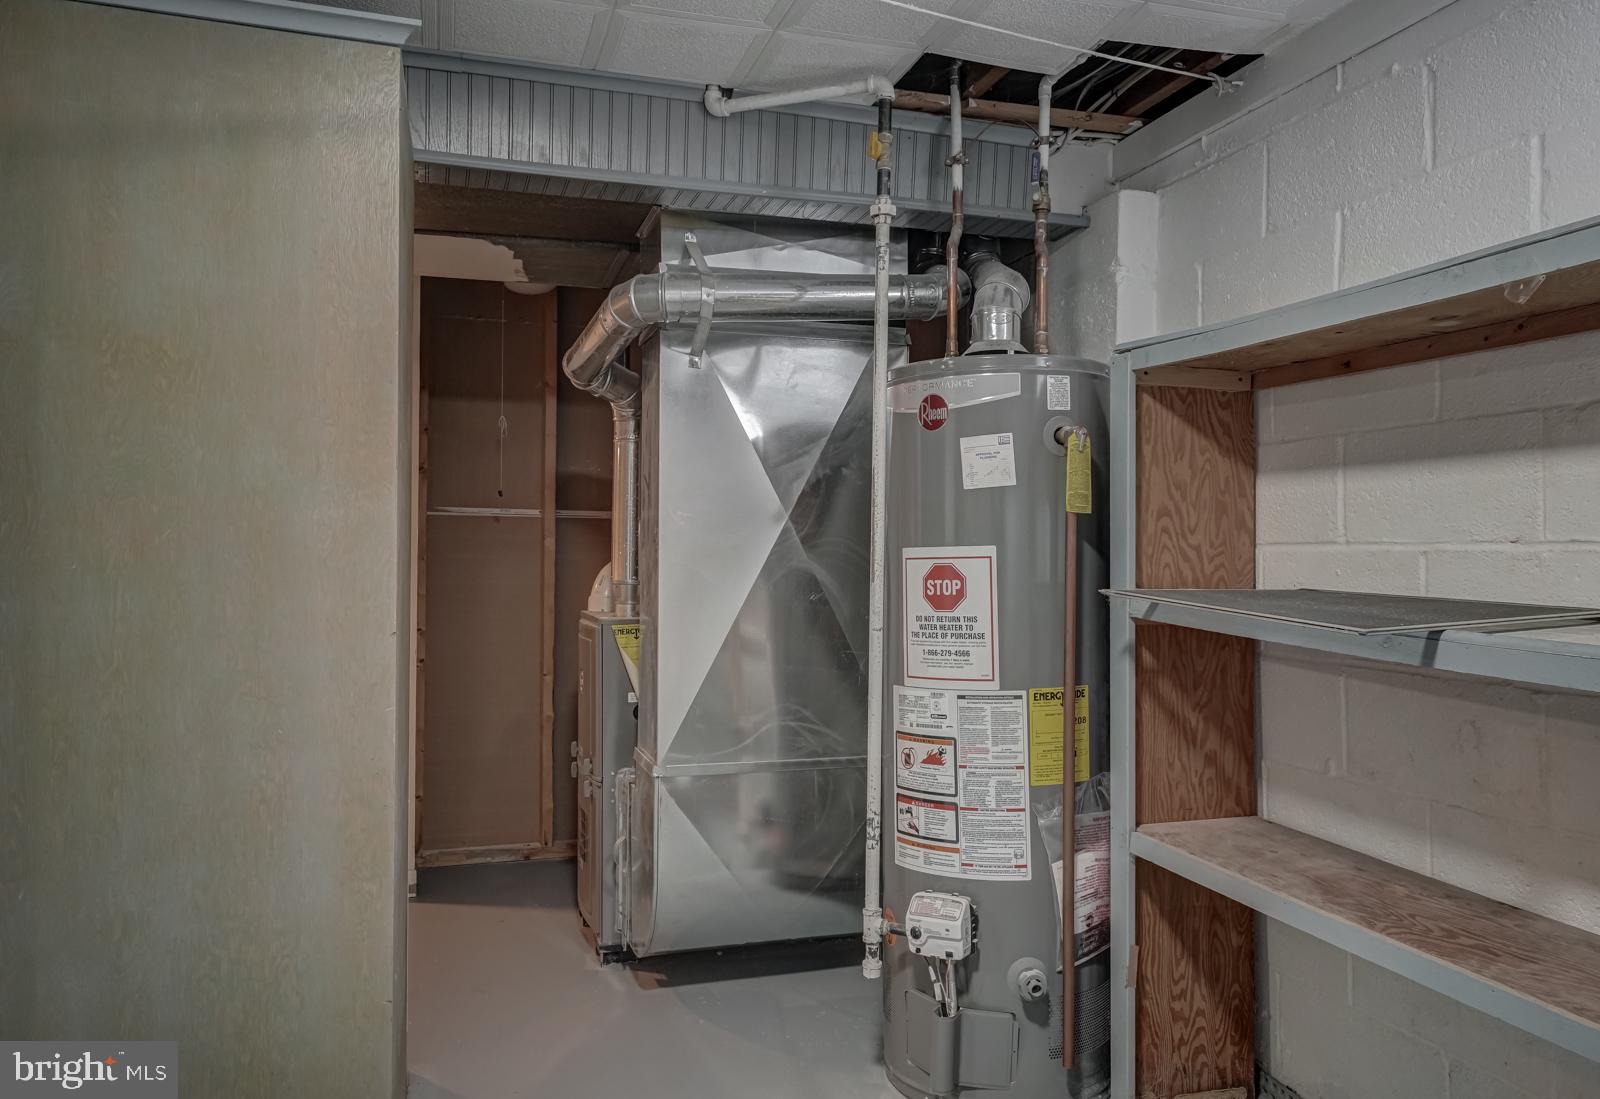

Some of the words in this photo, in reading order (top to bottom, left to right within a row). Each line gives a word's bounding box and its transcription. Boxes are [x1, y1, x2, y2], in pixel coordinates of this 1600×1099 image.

[904, 378, 976, 393] PERORMANCE
[921, 395, 948, 425] Rheem
[927, 579, 961, 596] STOP
[919, 623, 937, 631] WATER
[951, 632, 985, 640] PURCHASE
